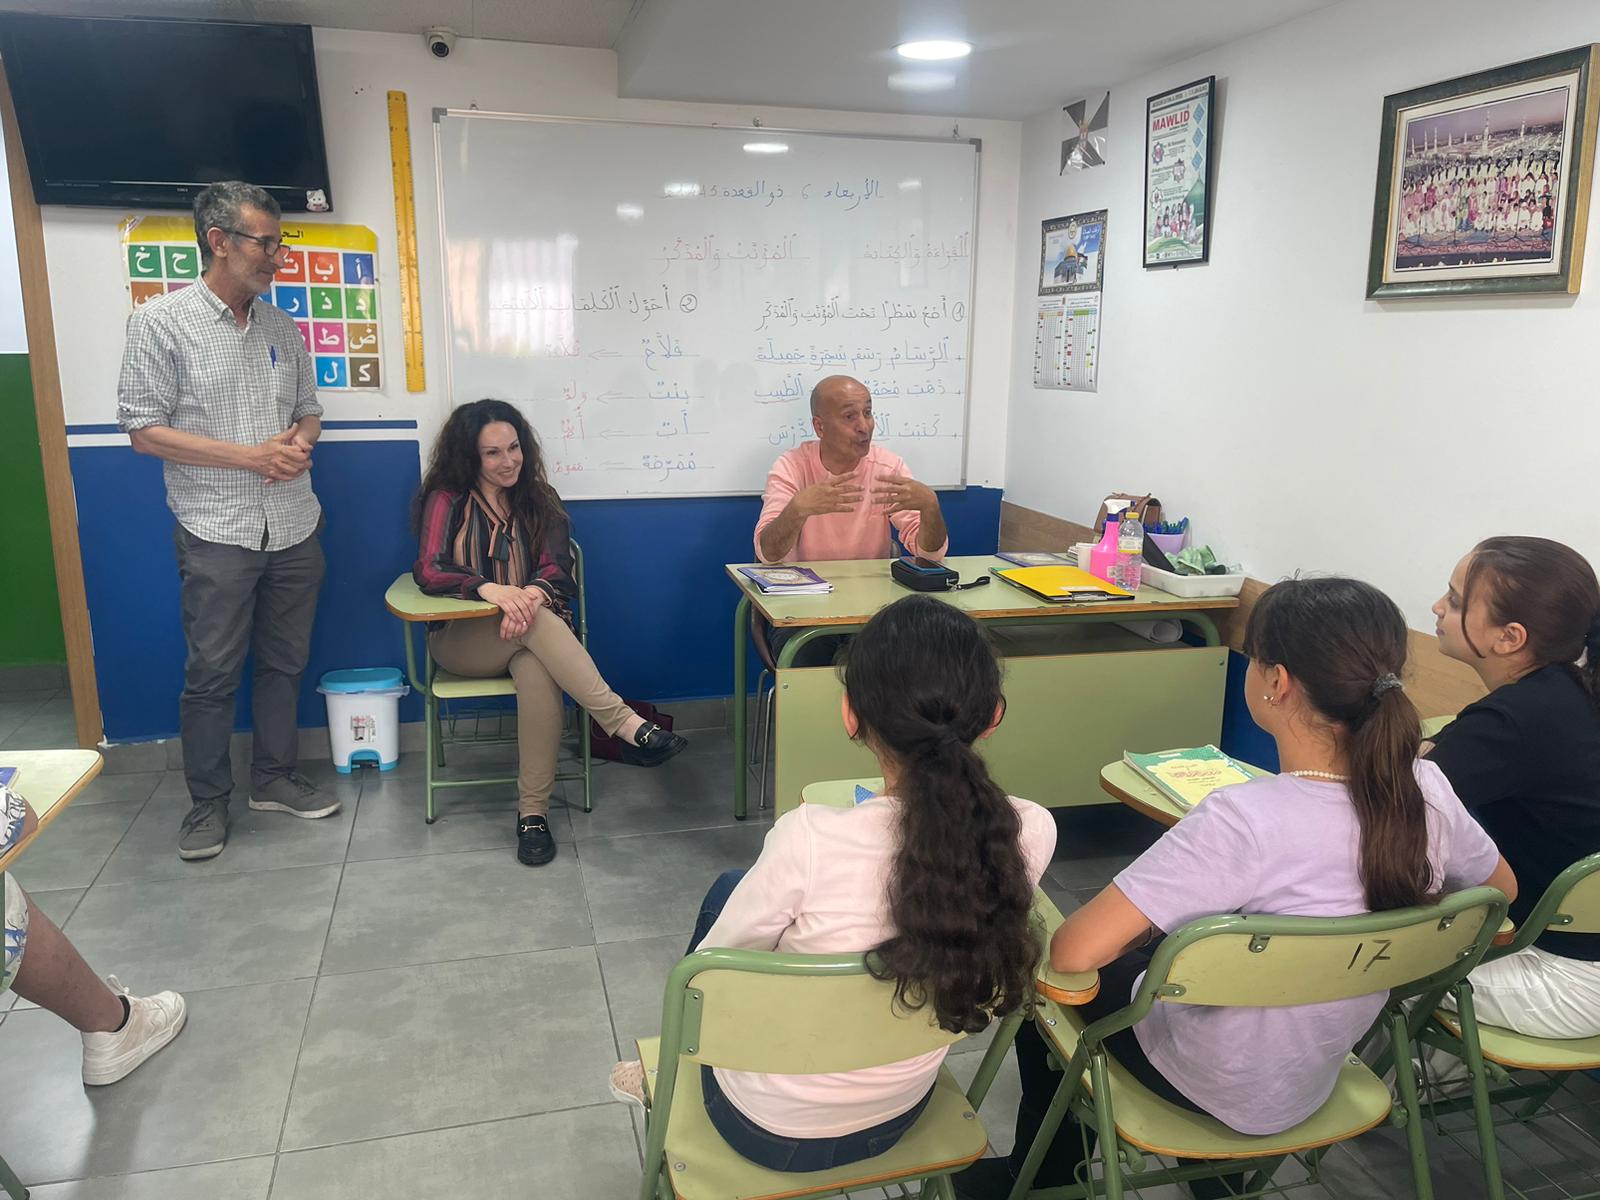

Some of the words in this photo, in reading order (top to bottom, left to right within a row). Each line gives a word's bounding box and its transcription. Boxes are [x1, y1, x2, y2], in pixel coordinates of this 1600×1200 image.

[1152, 110, 1190, 132] MAWLID
[135, 246, 155, 273] خ
[171, 252, 191, 274] ح
[314, 261, 334, 281] ب
[286, 297, 300, 313] ر
[321, 291, 333, 310] ذ
[355, 298, 366, 311] د
[318, 327, 340, 346] ط
[350, 327, 377, 349] ض
[323, 360, 338, 383] ل
[1347, 939, 1392, 972] 17
